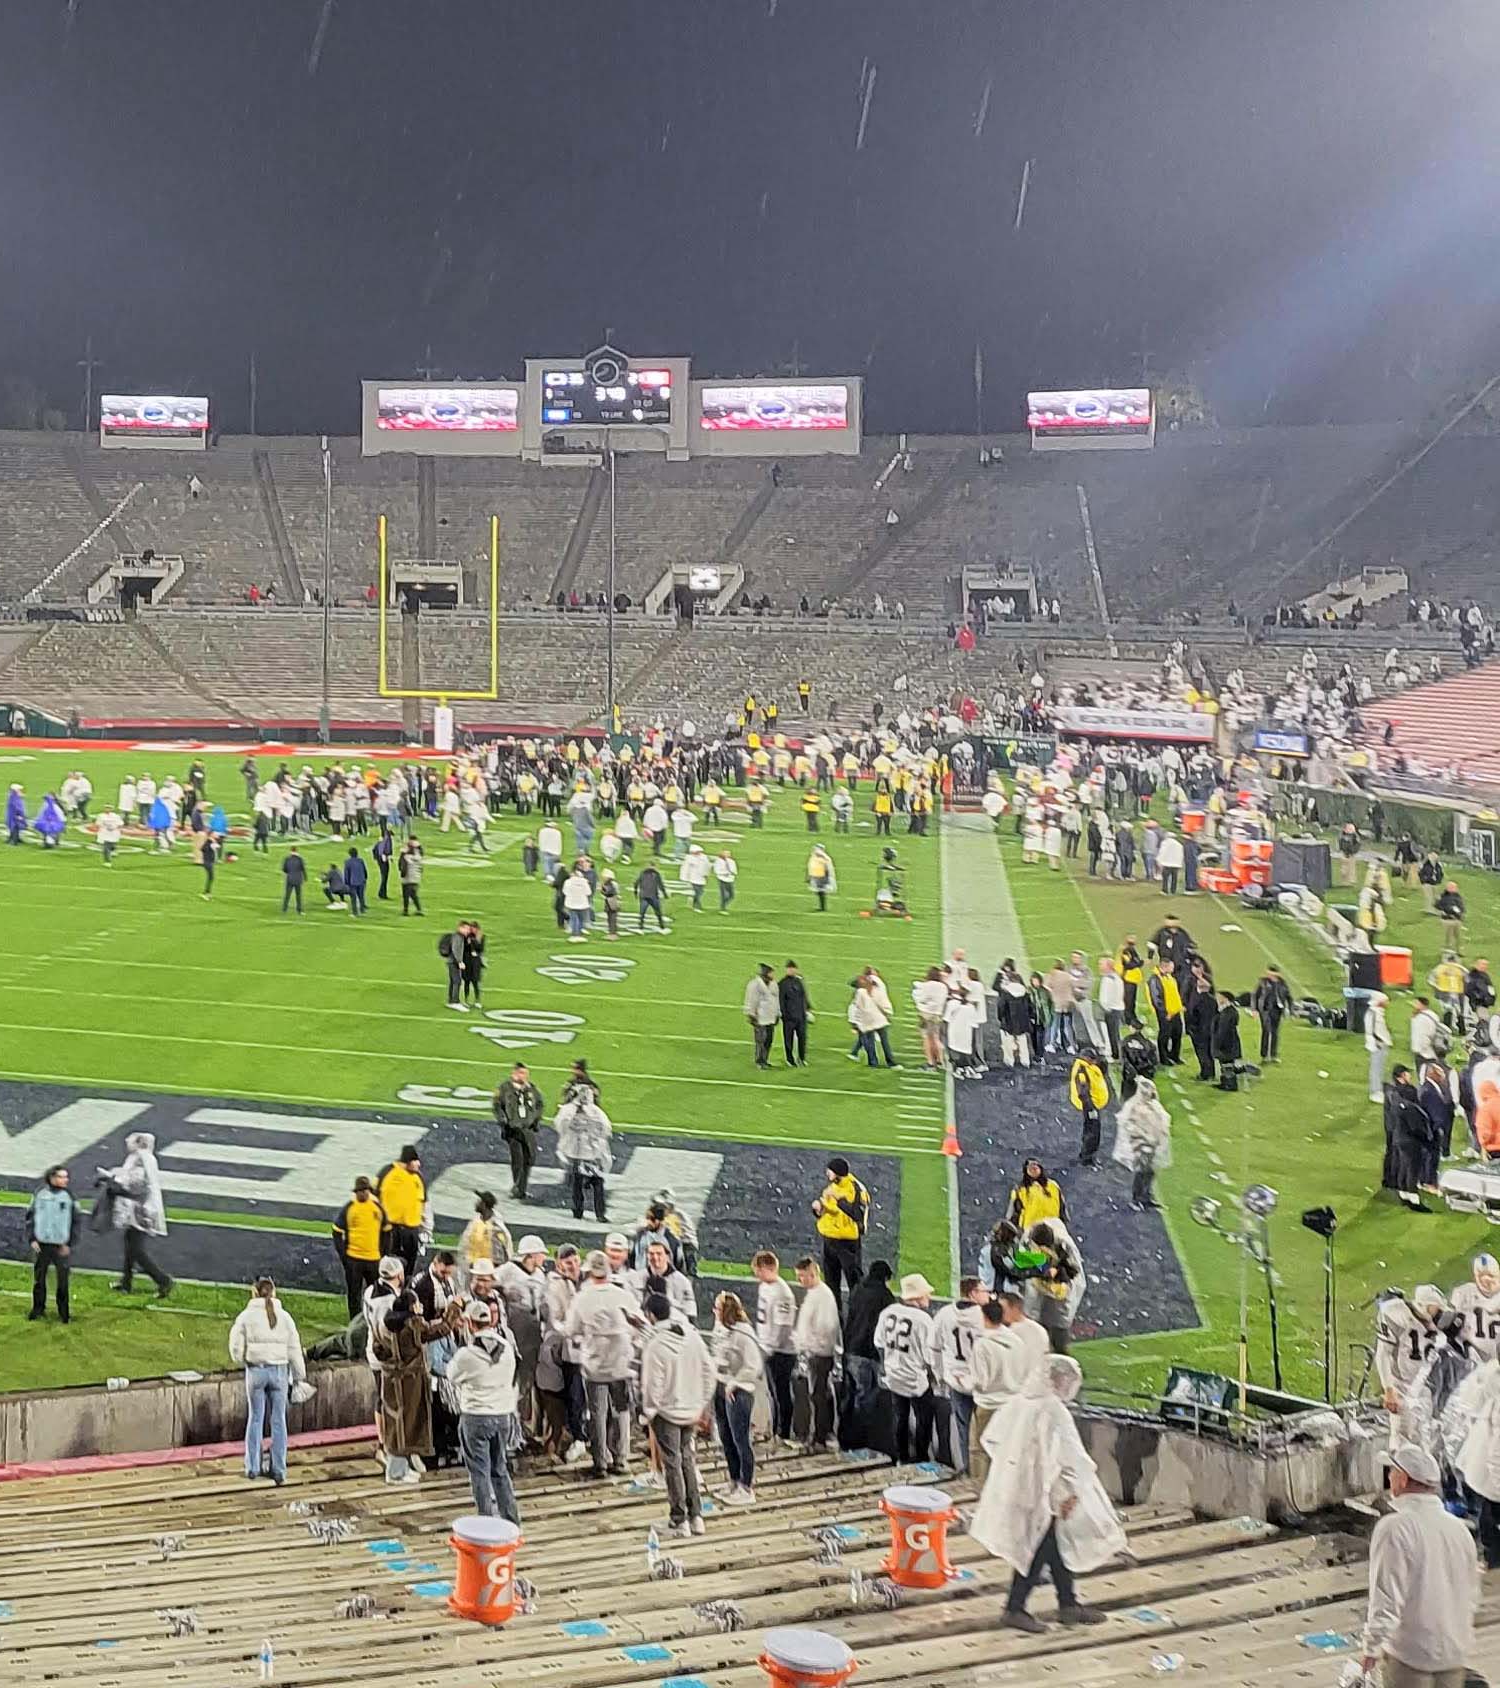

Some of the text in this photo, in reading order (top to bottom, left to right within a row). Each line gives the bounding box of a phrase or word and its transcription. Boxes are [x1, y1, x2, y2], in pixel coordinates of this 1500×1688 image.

[467, 1008, 587, 1044] 10
[886, 1313, 912, 1353] 22
[905, 1523, 931, 1551] G
[487, 1555, 510, 1585] G
